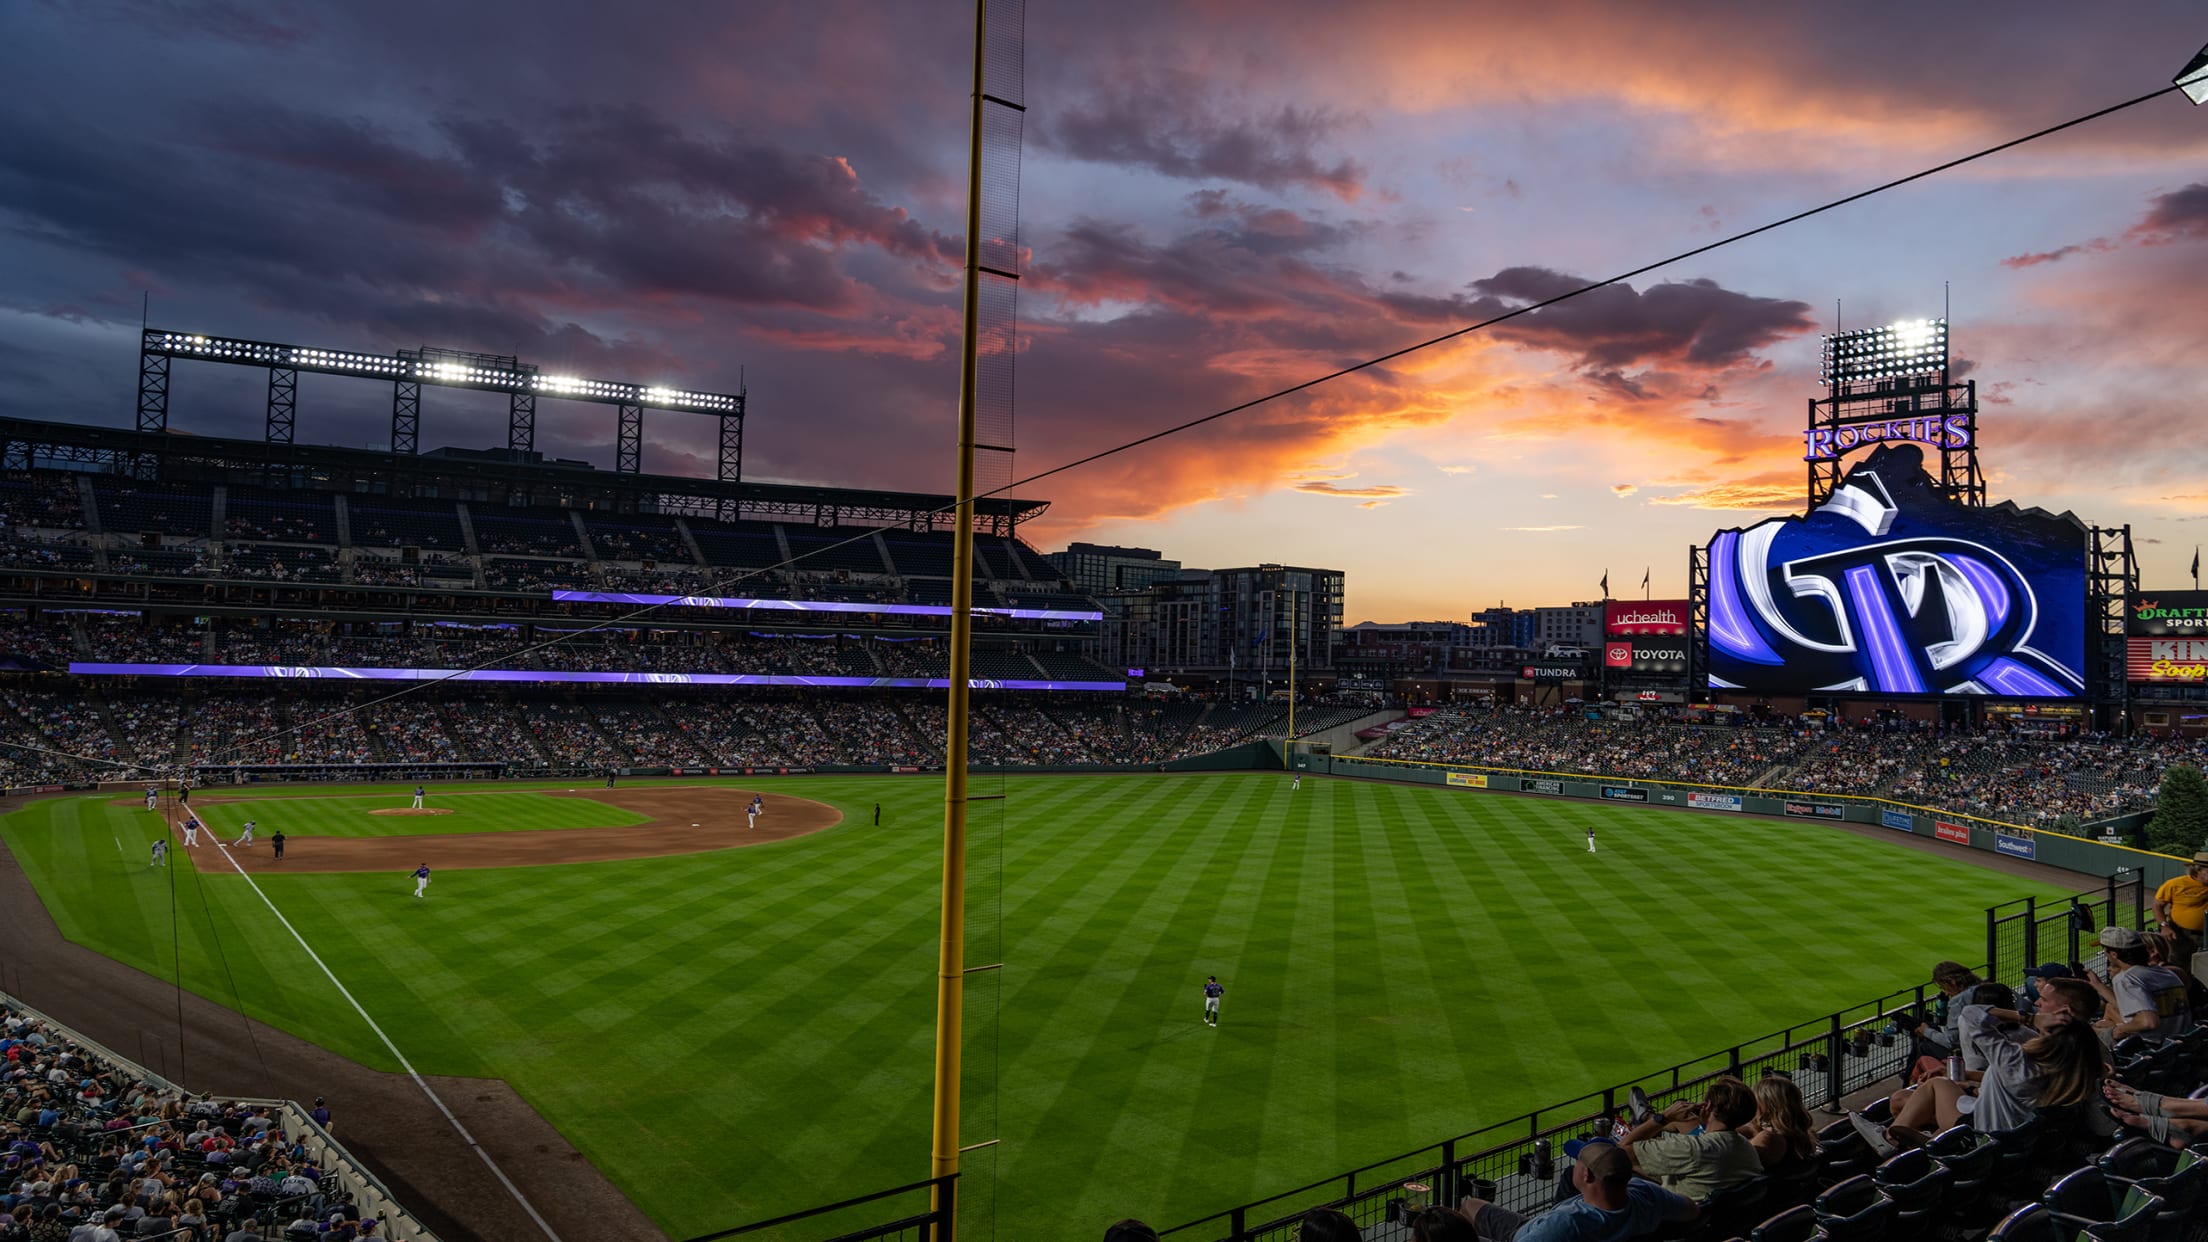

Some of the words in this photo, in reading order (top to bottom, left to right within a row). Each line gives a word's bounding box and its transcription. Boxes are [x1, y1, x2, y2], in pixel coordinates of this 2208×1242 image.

[1803, 415, 1971, 460] ROCKIES
[1617, 609, 1677, 624] uchealth
[2136, 608, 2208, 620] DRAFT
[1632, 649, 1686, 660] TOYOTA
[1534, 668, 1577, 677] TUNDRA
[1695, 794, 1734, 804] BETFRED
[1998, 839, 2029, 853] Southwest
